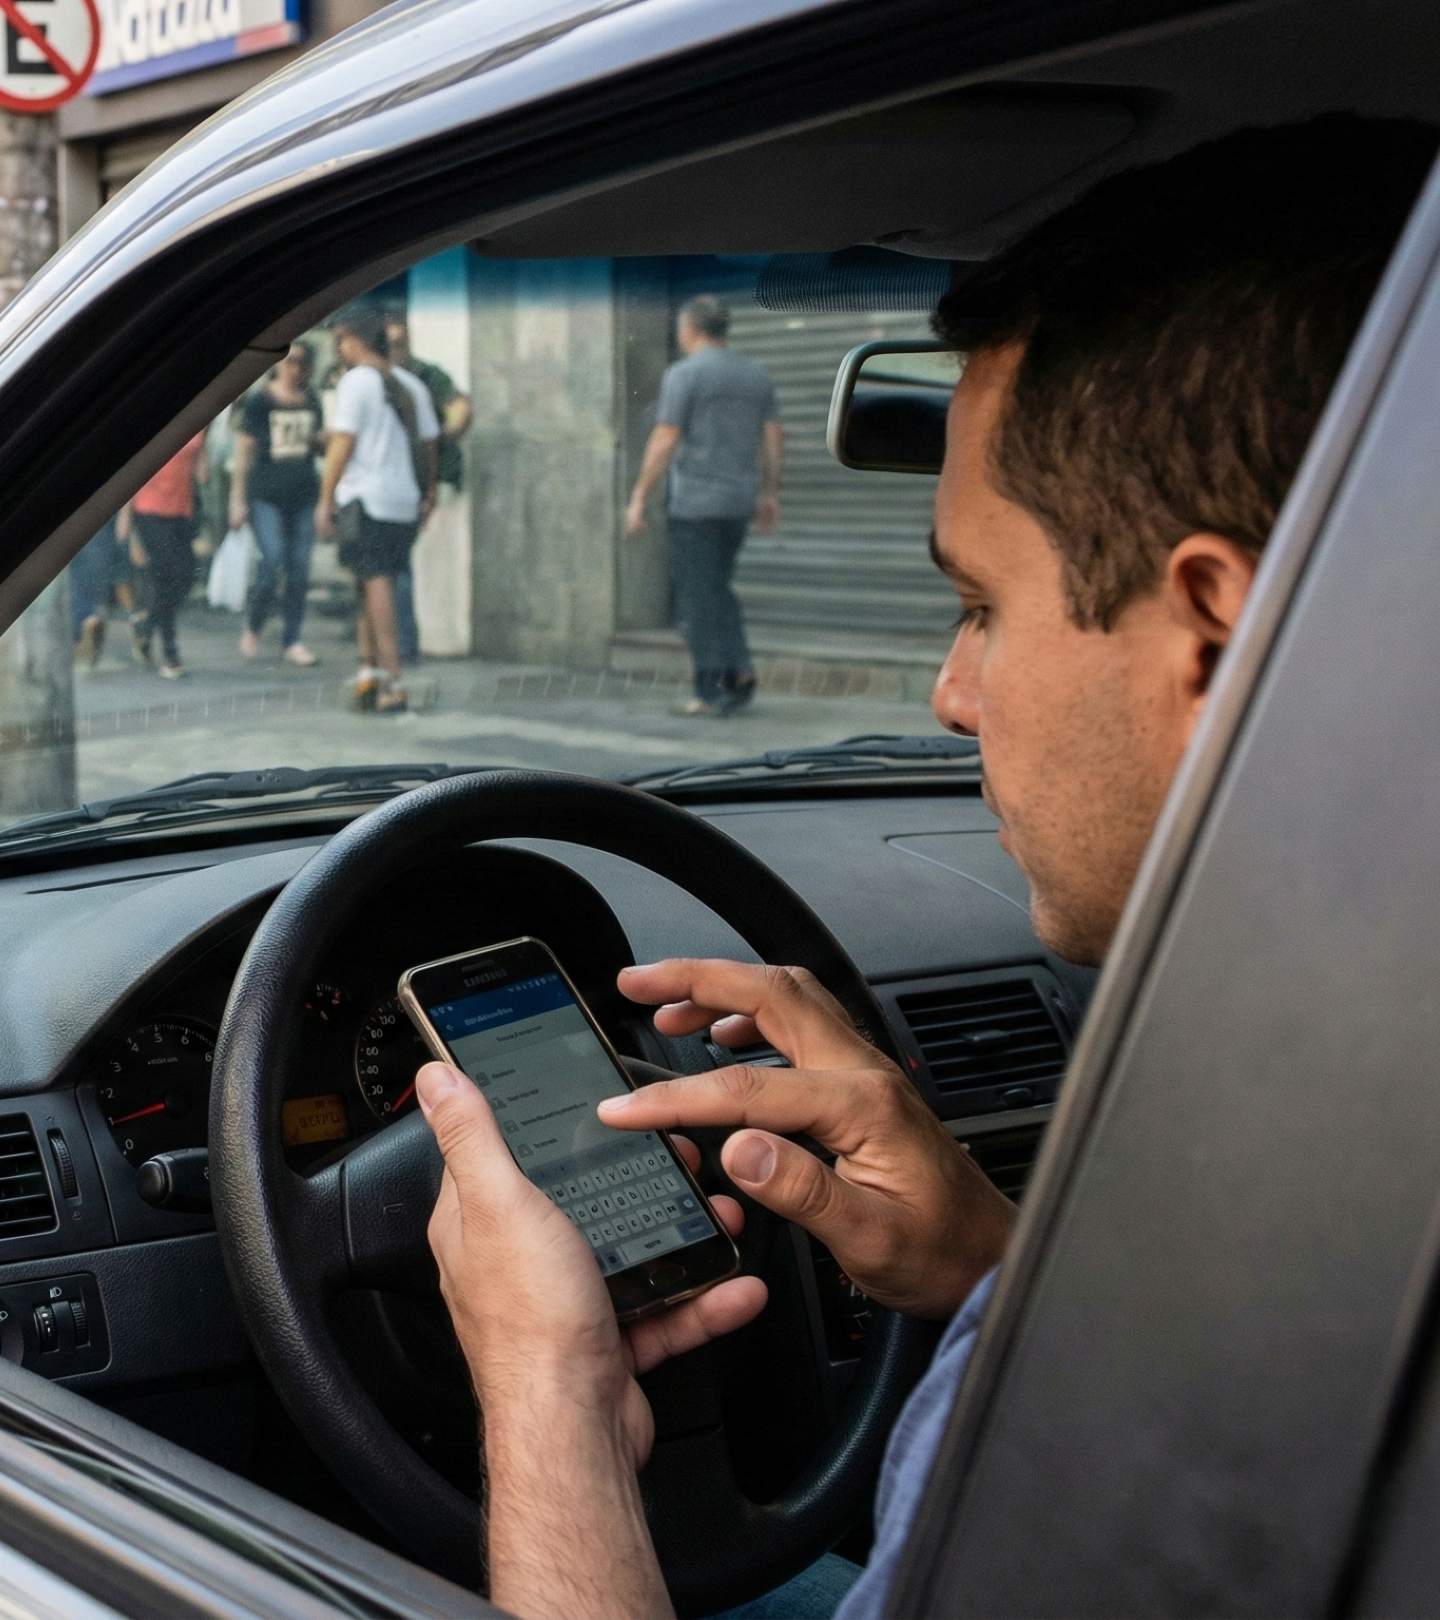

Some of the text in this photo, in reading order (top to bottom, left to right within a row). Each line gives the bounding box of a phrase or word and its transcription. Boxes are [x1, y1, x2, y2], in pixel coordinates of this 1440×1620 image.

[181, 1035, 189, 1045] 6
[113, 1062, 122, 1073] 3
[105, 1087, 115, 1099] 2
[125, 1138, 134, 1150] 0
